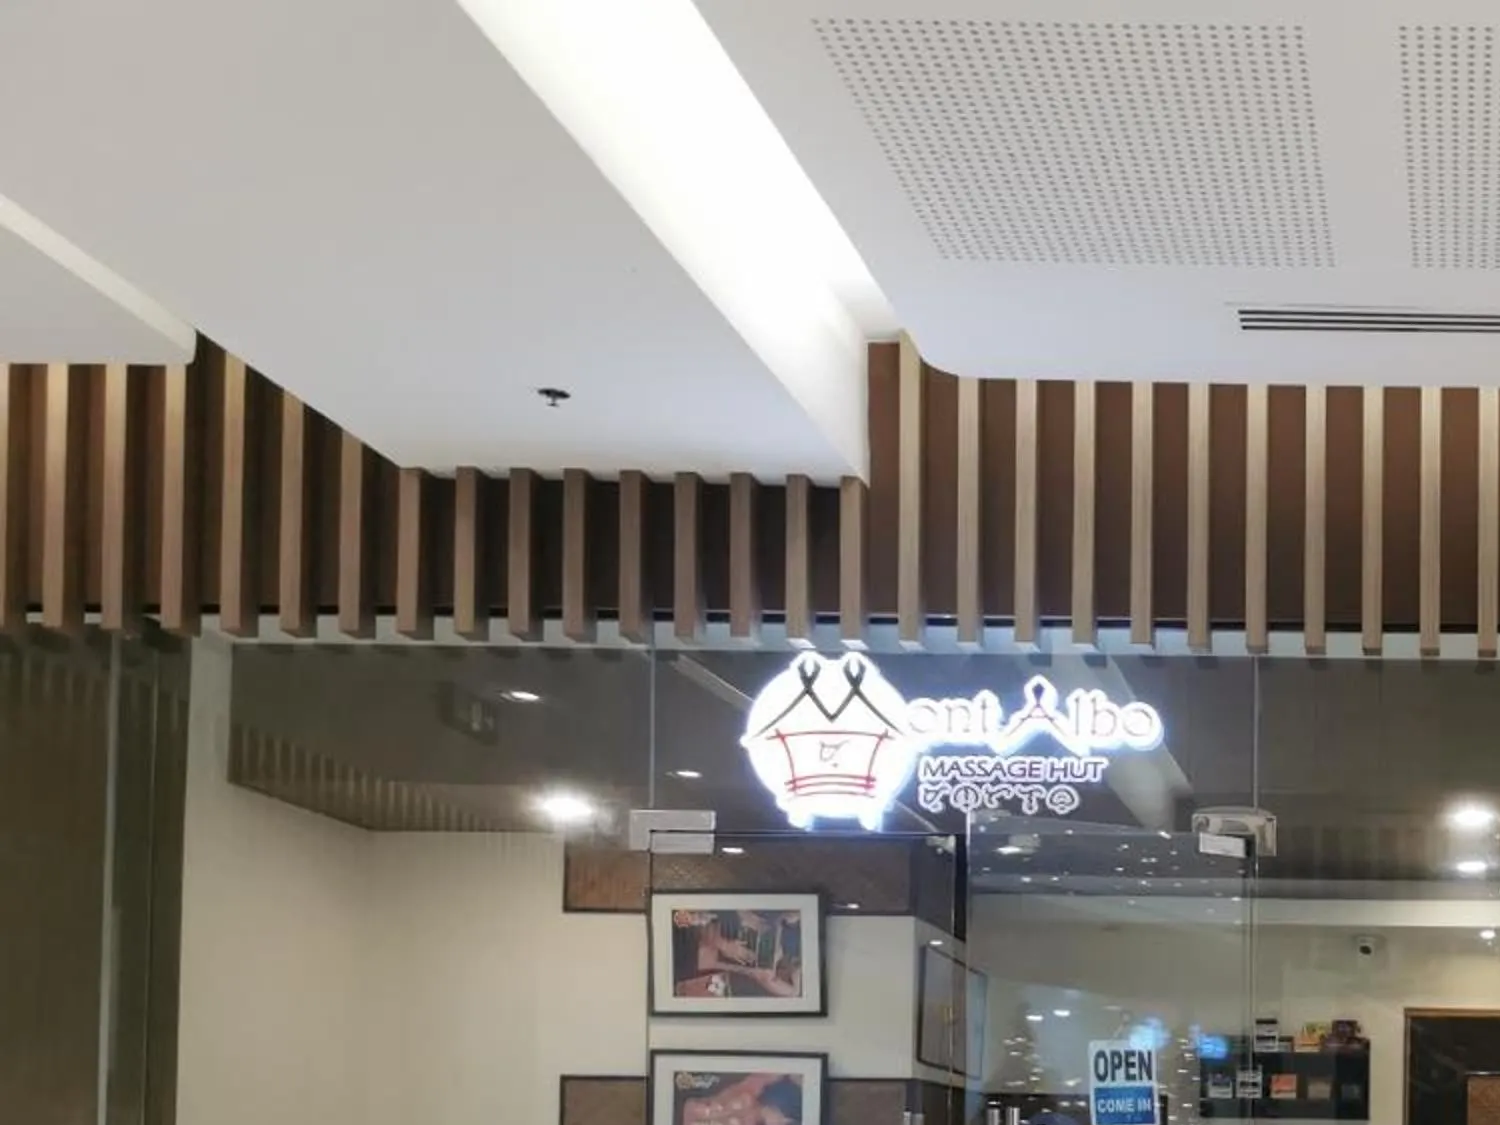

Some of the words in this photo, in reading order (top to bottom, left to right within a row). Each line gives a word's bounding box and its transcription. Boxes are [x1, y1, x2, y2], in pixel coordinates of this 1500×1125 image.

[922, 758, 1042, 781] MASSAGE
[1048, 758, 1106, 780] HUT
[1094, 1049, 1153, 1083] OPEN
[1097, 1098, 1135, 1113] COME
[1137, 1097, 1153, 1112] IN
